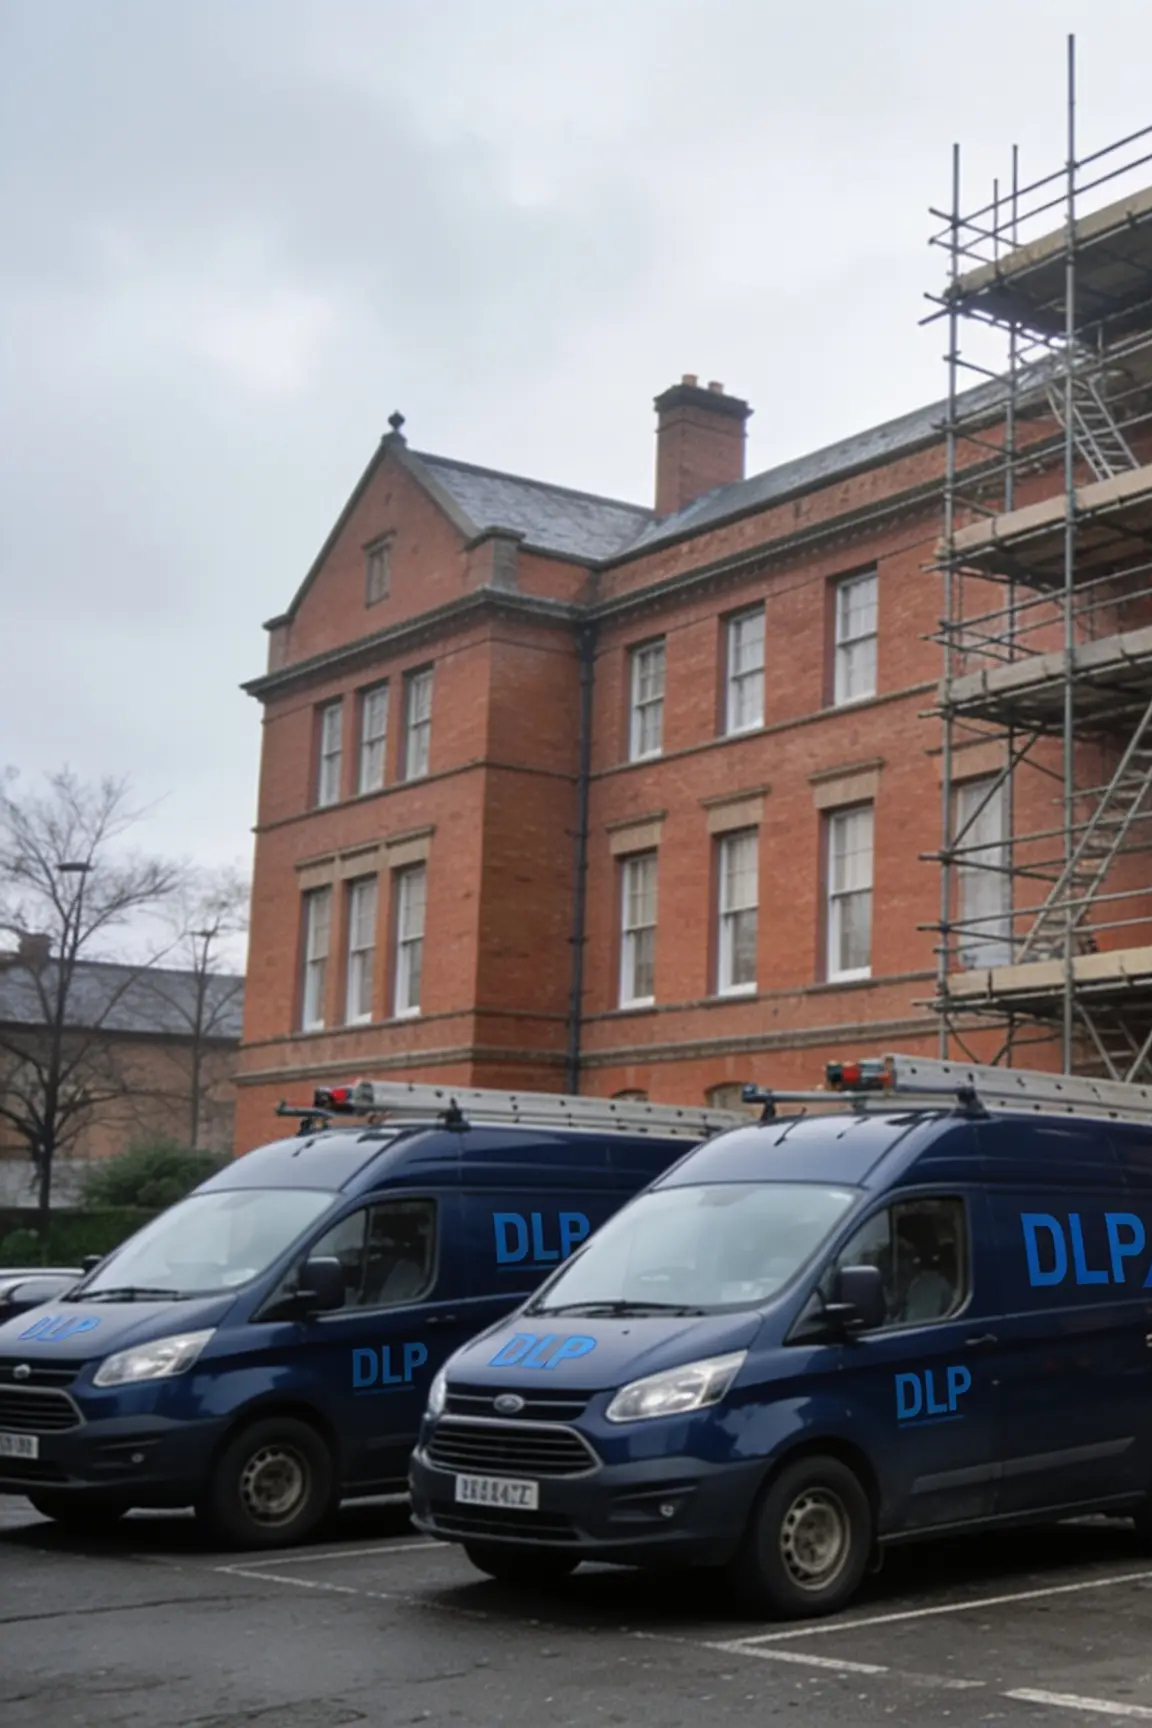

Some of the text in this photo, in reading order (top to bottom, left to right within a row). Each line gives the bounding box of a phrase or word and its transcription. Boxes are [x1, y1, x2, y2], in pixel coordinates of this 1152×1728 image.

[493, 1212, 590, 1263] DLP
[1020, 1213, 1145, 1287] DLP
[18, 1316, 101, 1341] DLP
[488, 1333, 597, 1370] DLP
[352, 1342, 428, 1388] DLP
[895, 1366, 971, 1419] DLP
